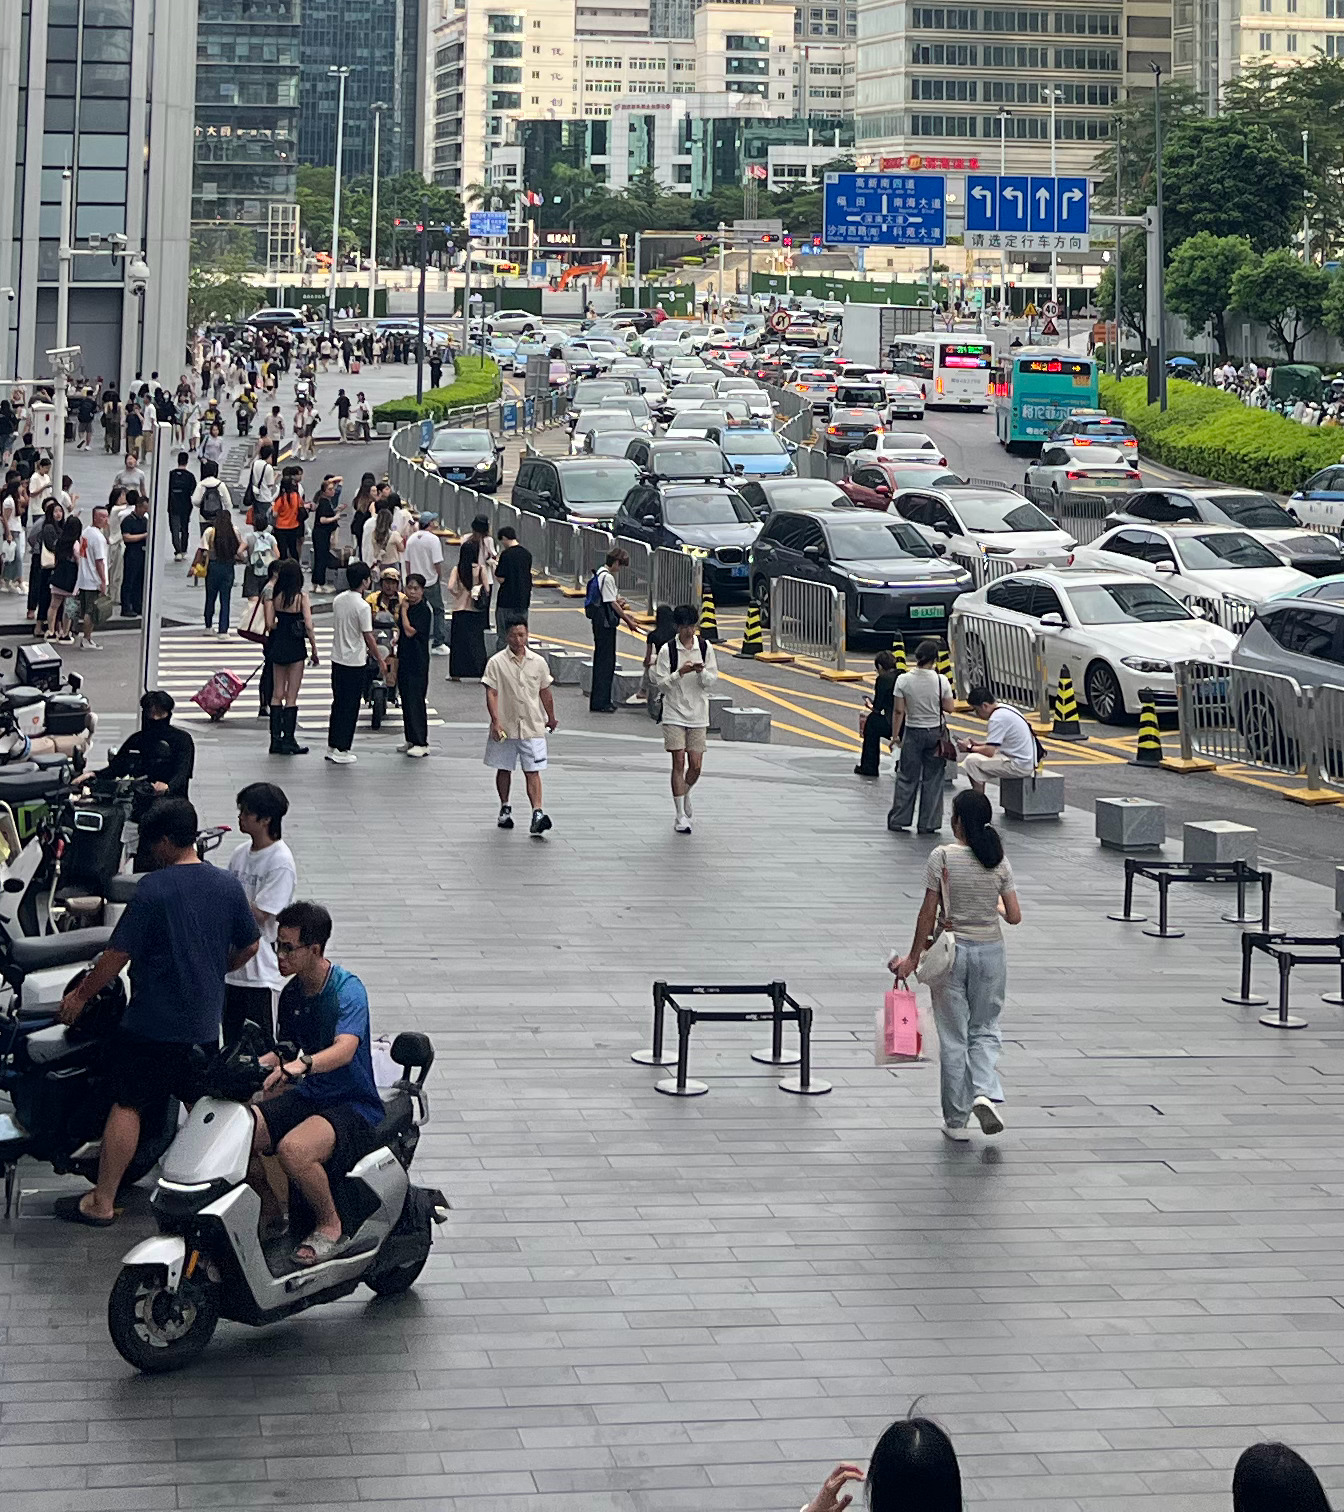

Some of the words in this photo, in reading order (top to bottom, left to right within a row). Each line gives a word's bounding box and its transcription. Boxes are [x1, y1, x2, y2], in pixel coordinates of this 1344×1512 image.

[856, 177, 915, 189] 高新南四道
[837, 196, 866, 207] 福田
[893, 197, 941, 209] 南海大道
[972, 233, 1081, 249] 请选定行车方向
[1046, 304, 1056, 315] 40
